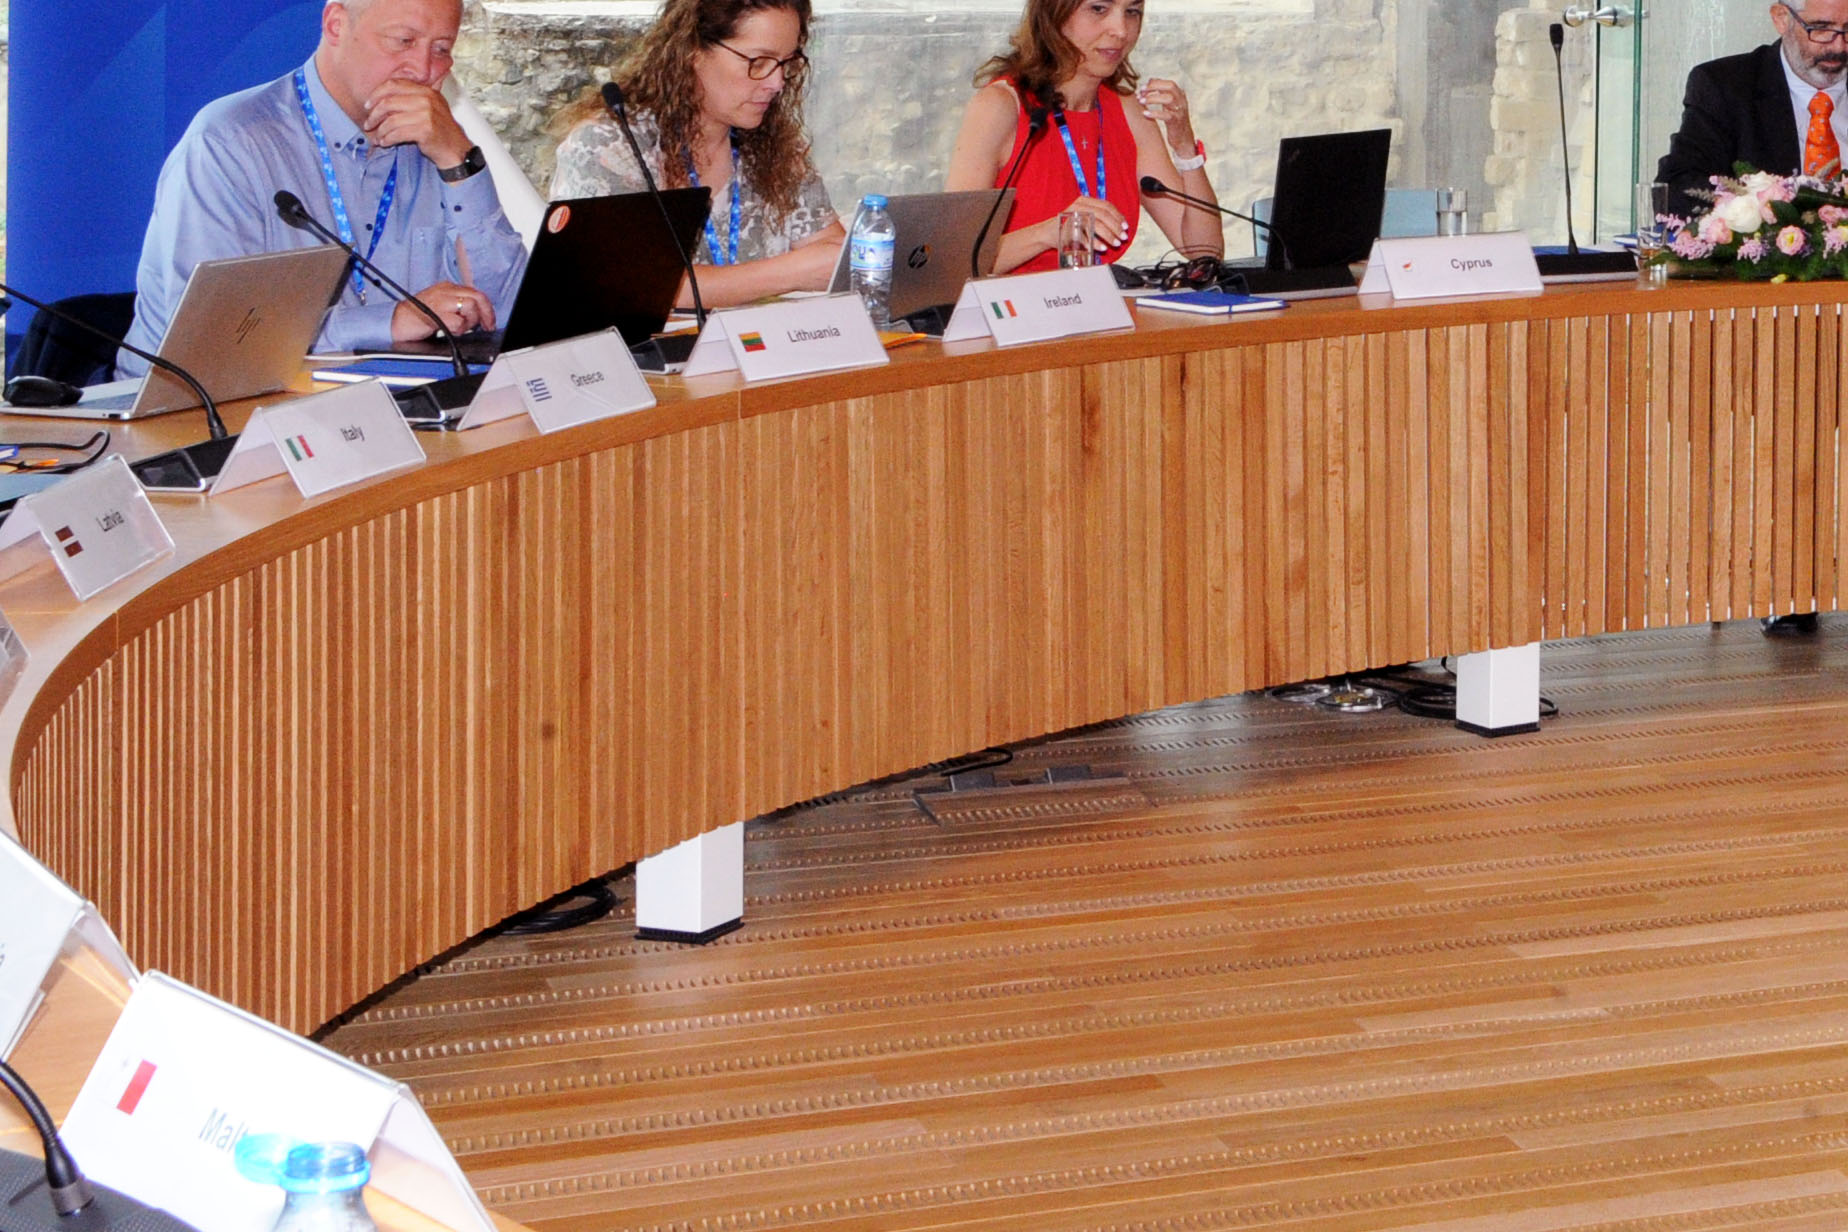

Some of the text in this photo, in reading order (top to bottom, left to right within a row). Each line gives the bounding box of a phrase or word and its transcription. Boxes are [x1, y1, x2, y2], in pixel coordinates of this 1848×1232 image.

[1450, 258, 1493, 272] Cyprus
[1043, 293, 1082, 308] Ireland
[787, 325, 841, 343] Lithuania
[340, 424, 365, 442] Italy
[96, 510, 124, 532] Latvia
[198, 1107, 247, 1153] Mal
